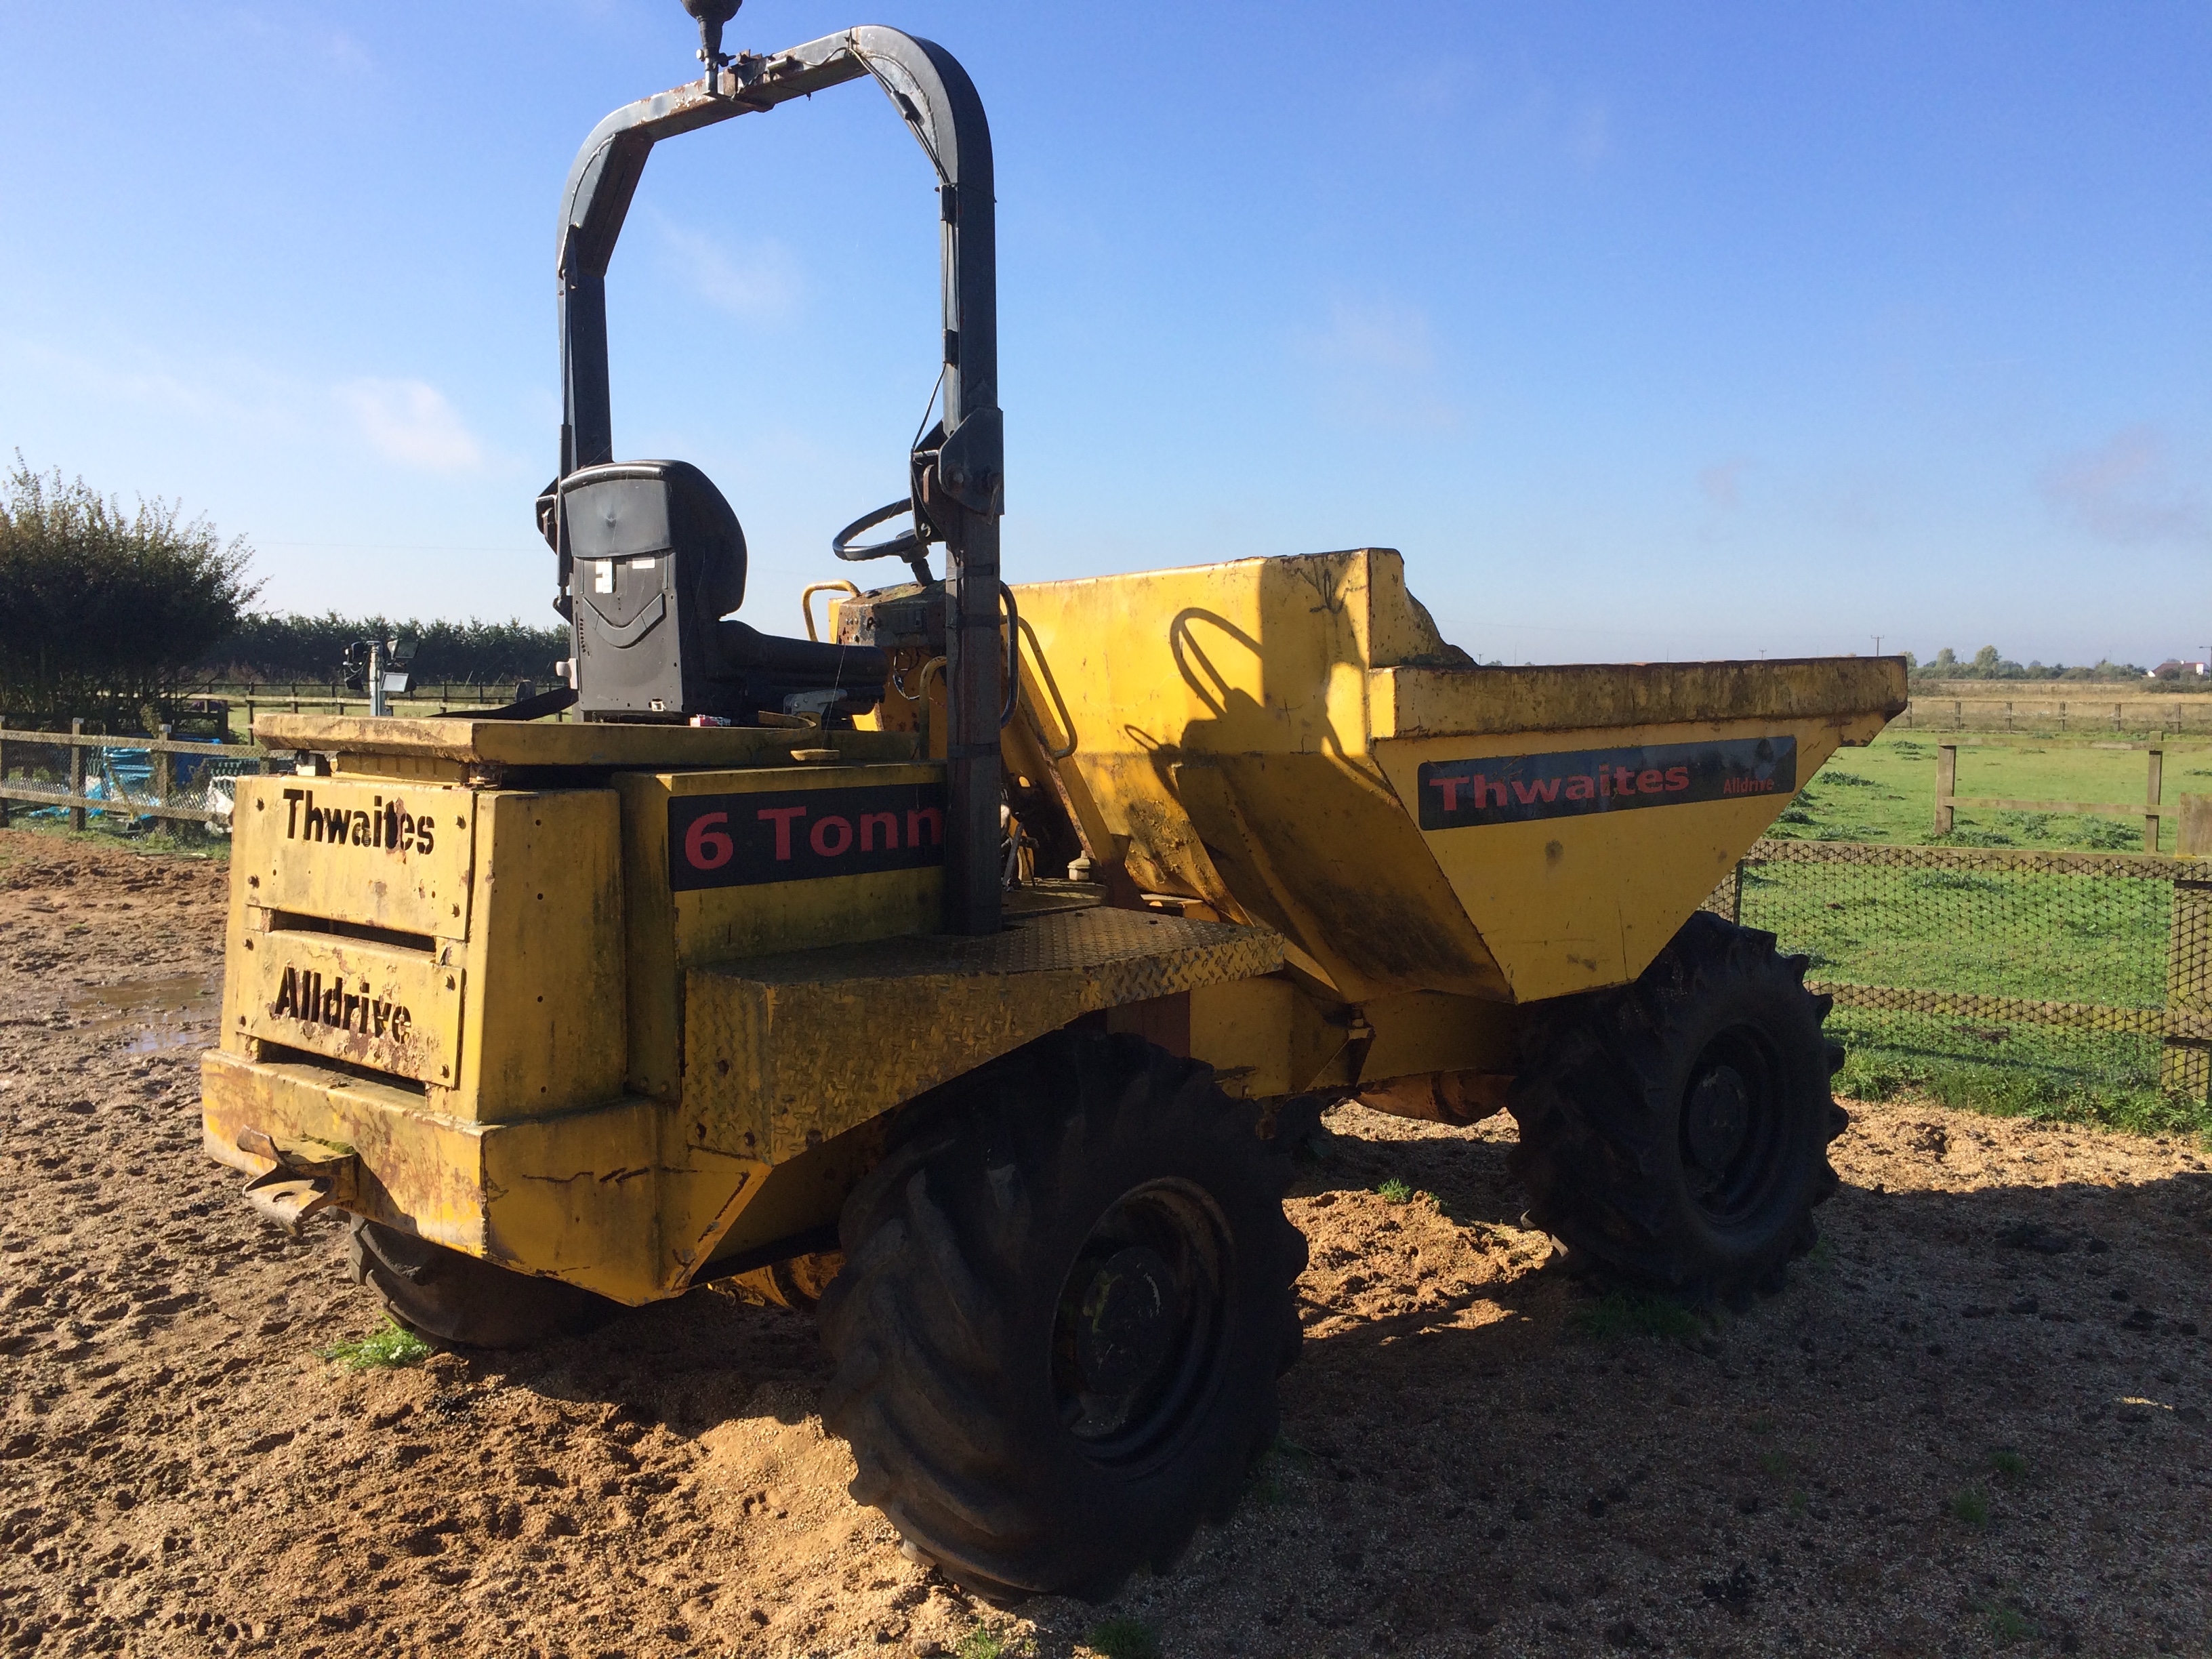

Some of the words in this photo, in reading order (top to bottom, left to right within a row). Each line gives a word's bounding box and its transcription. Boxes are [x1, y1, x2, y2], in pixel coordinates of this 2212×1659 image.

[1429, 764, 1689, 811] Thwaites
[1723, 776, 1774, 794] Alldrive
[283, 788, 434, 855] Thwaites
[685, 813, 734, 869] 6
[758, 806, 943, 861] Tonn
[274, 966, 411, 1044] Alldrive
